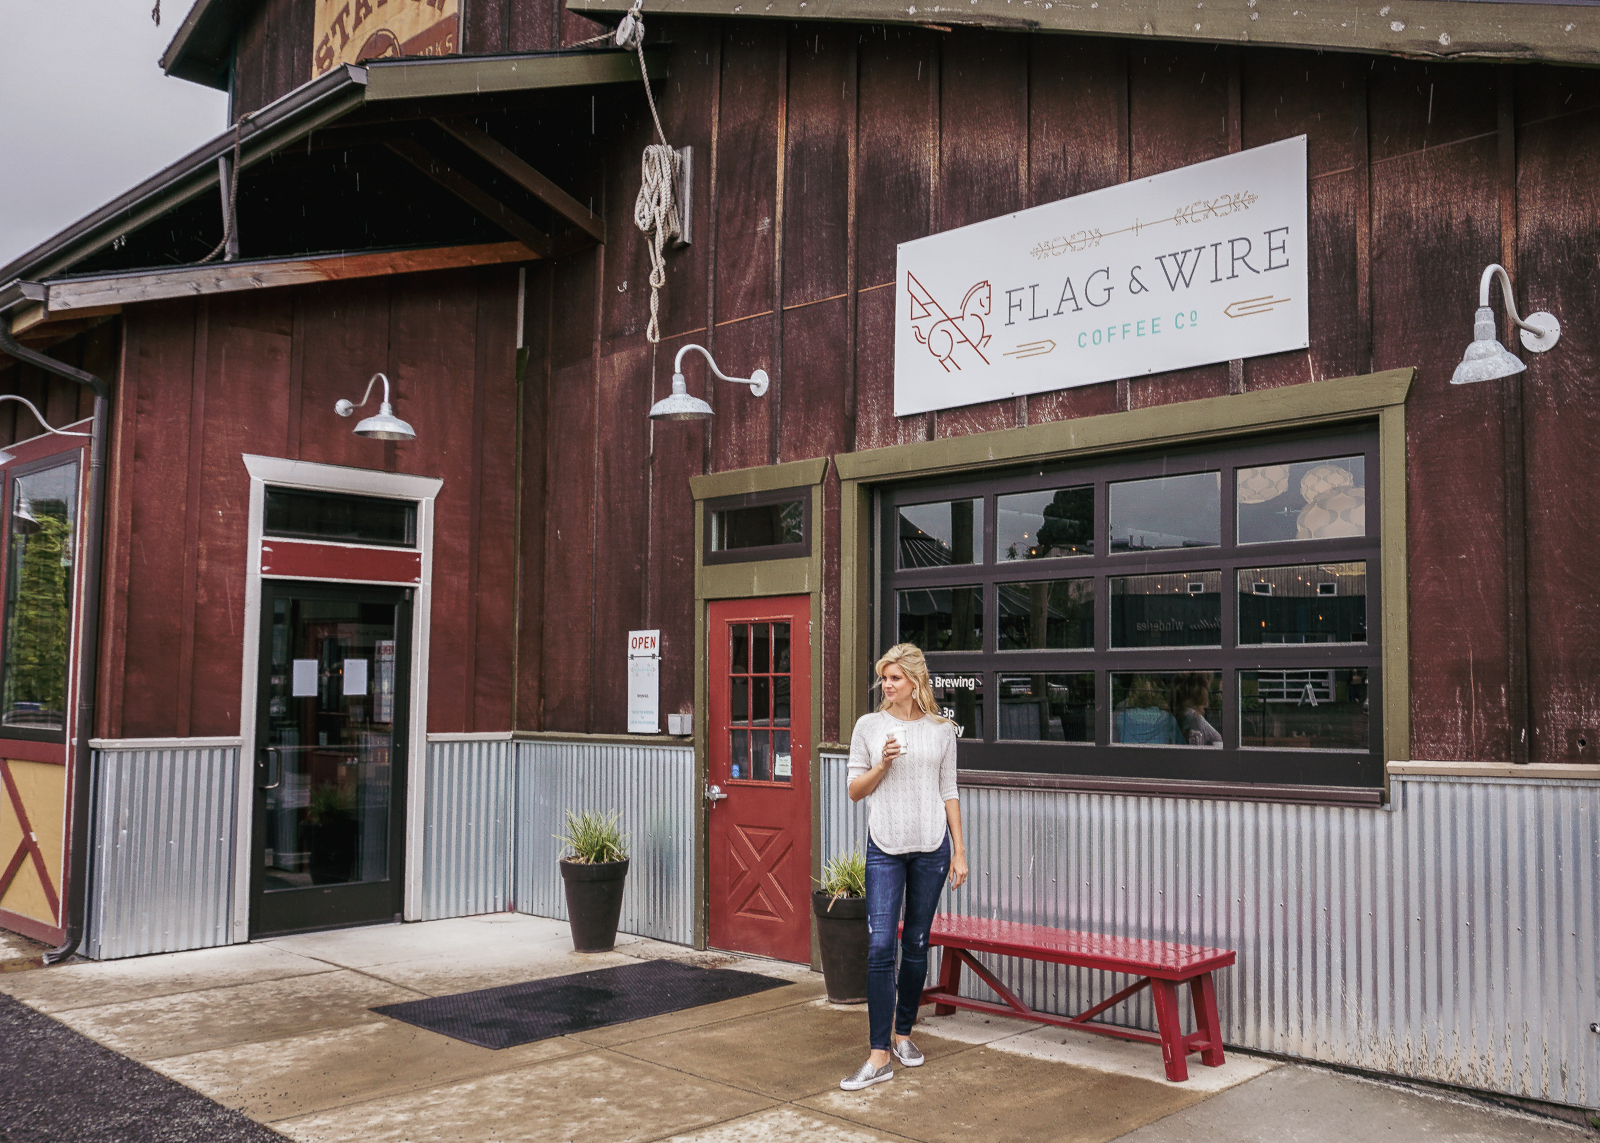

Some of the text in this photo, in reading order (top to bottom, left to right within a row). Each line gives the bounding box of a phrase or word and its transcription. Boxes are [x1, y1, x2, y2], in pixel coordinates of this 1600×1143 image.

[1004, 226, 1290, 327] FLAG & WIRE
[1077, 316, 1162, 348] COFFEE
[631, 636, 656, 650] OPEN
[934, 675, 975, 691] Brewing
